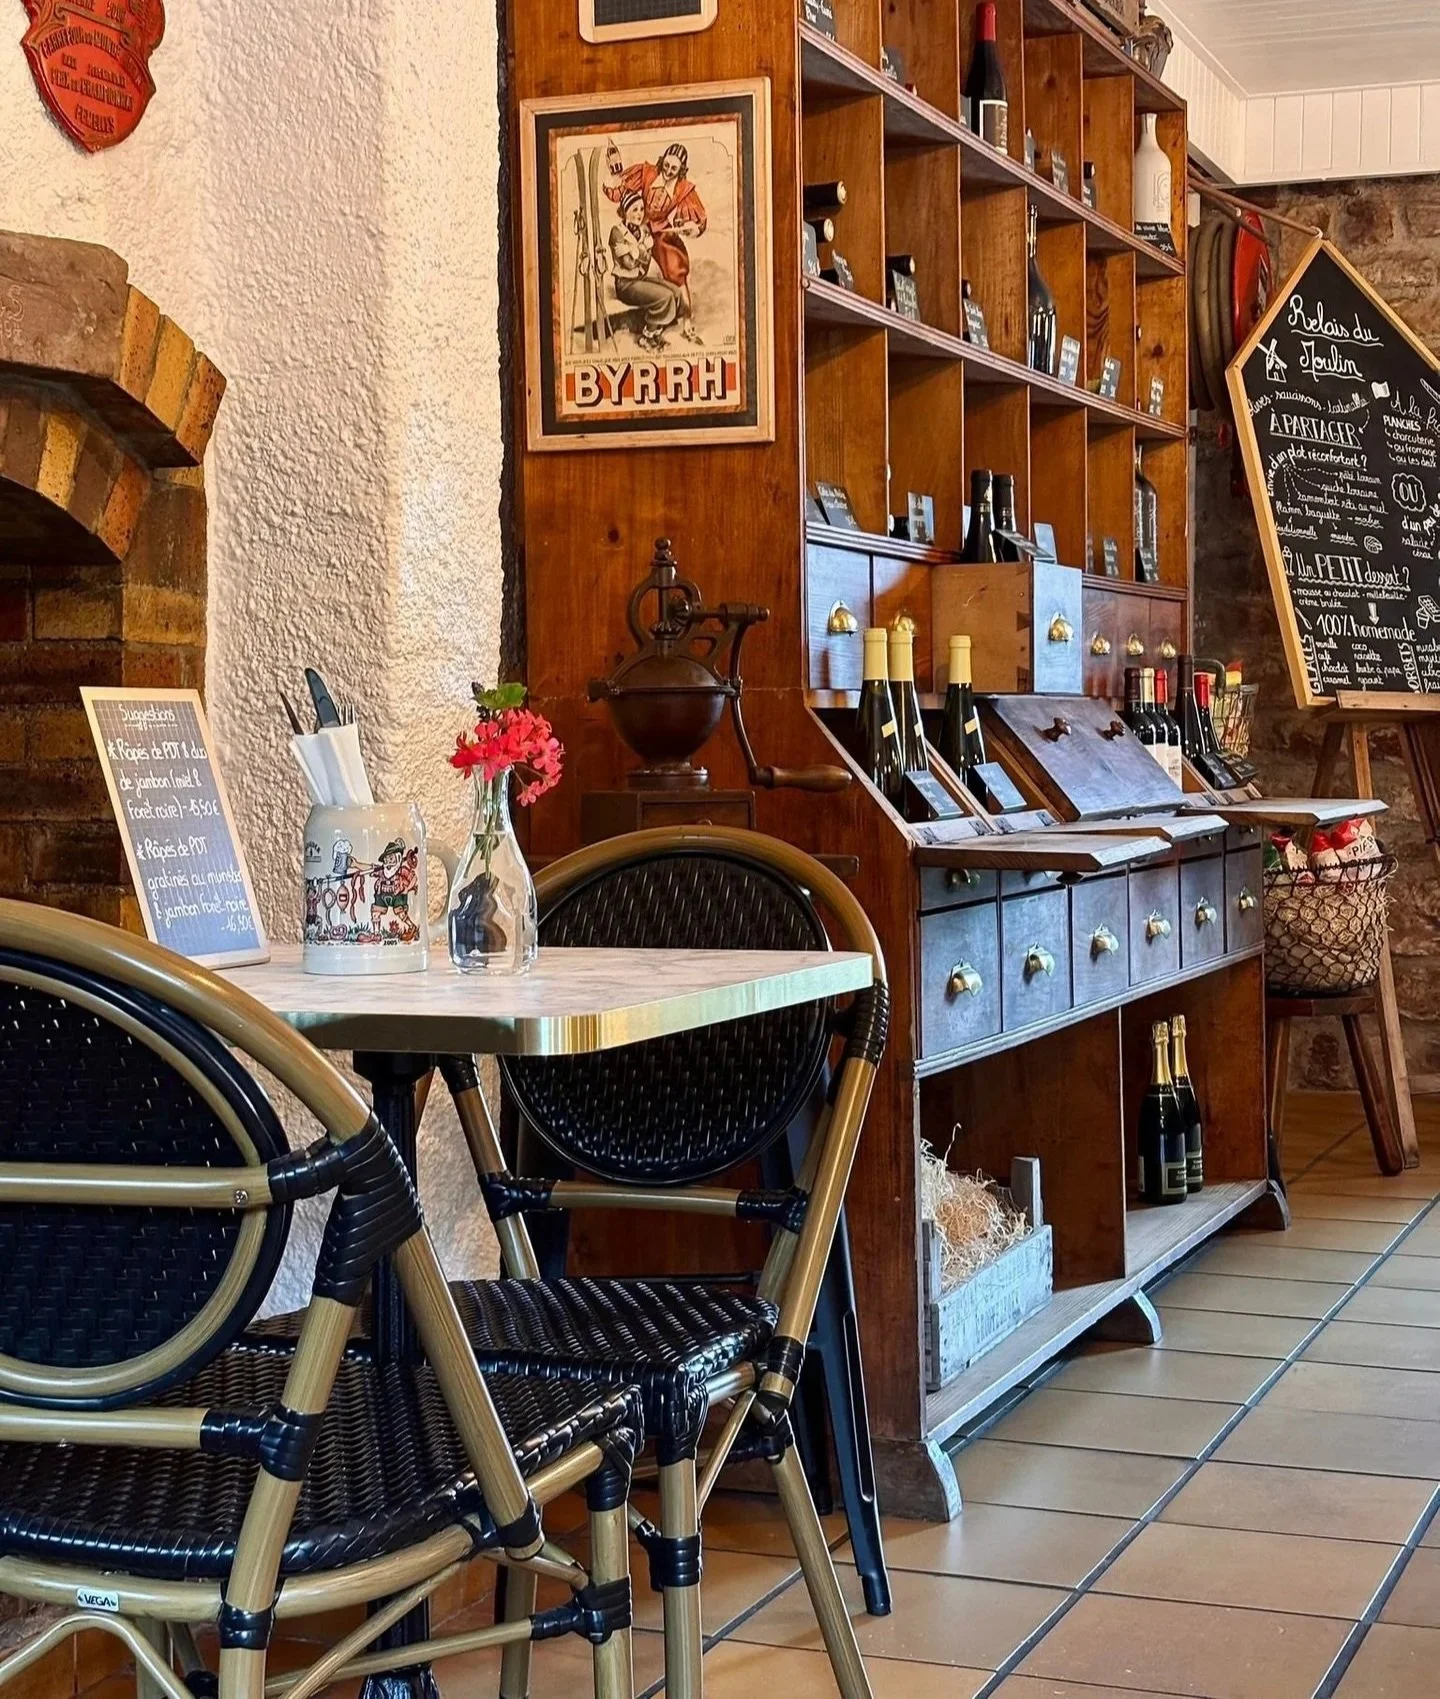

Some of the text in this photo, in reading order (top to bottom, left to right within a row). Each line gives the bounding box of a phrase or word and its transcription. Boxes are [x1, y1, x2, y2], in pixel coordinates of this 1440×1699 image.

[1288, 294, 1380, 342] Relais du
[1300, 340, 1363, 382] Moulin
[574, 357, 727, 407] BYRRH
[1282, 414, 1361, 446] PARTAGER
[1383, 414, 1421, 431] PLANCHES
[1392, 429, 1435, 446] charcuterie
[1400, 482, 1418, 503] OU
[1295, 552, 1317, 578] Un
[1364, 560, 1403, 586] dessert
[1297, 587, 1322, 598] mousse
[1332, 588, 1360, 599] chocolat
[1316, 614, 1417, 642] 100% homemade
[1352, 643, 1367, 651] coco
[1300, 634, 1321, 694] GLACES
[1321, 662, 1349, 673] chocolat
[1398, 642, 1420, 694] ORBETS
[118, 704, 176, 730] Suggestions
[151, 741, 163, 760] de
[191, 741, 208, 760] duo
[120, 768, 134, 791] de
[135, 770, 169, 798] jambon
[148, 867, 189, 900] gratinés
[192, 873, 206, 886] au
[164, 899, 200, 929] jambon
[84, 1594, 111, 1607] VEGA
